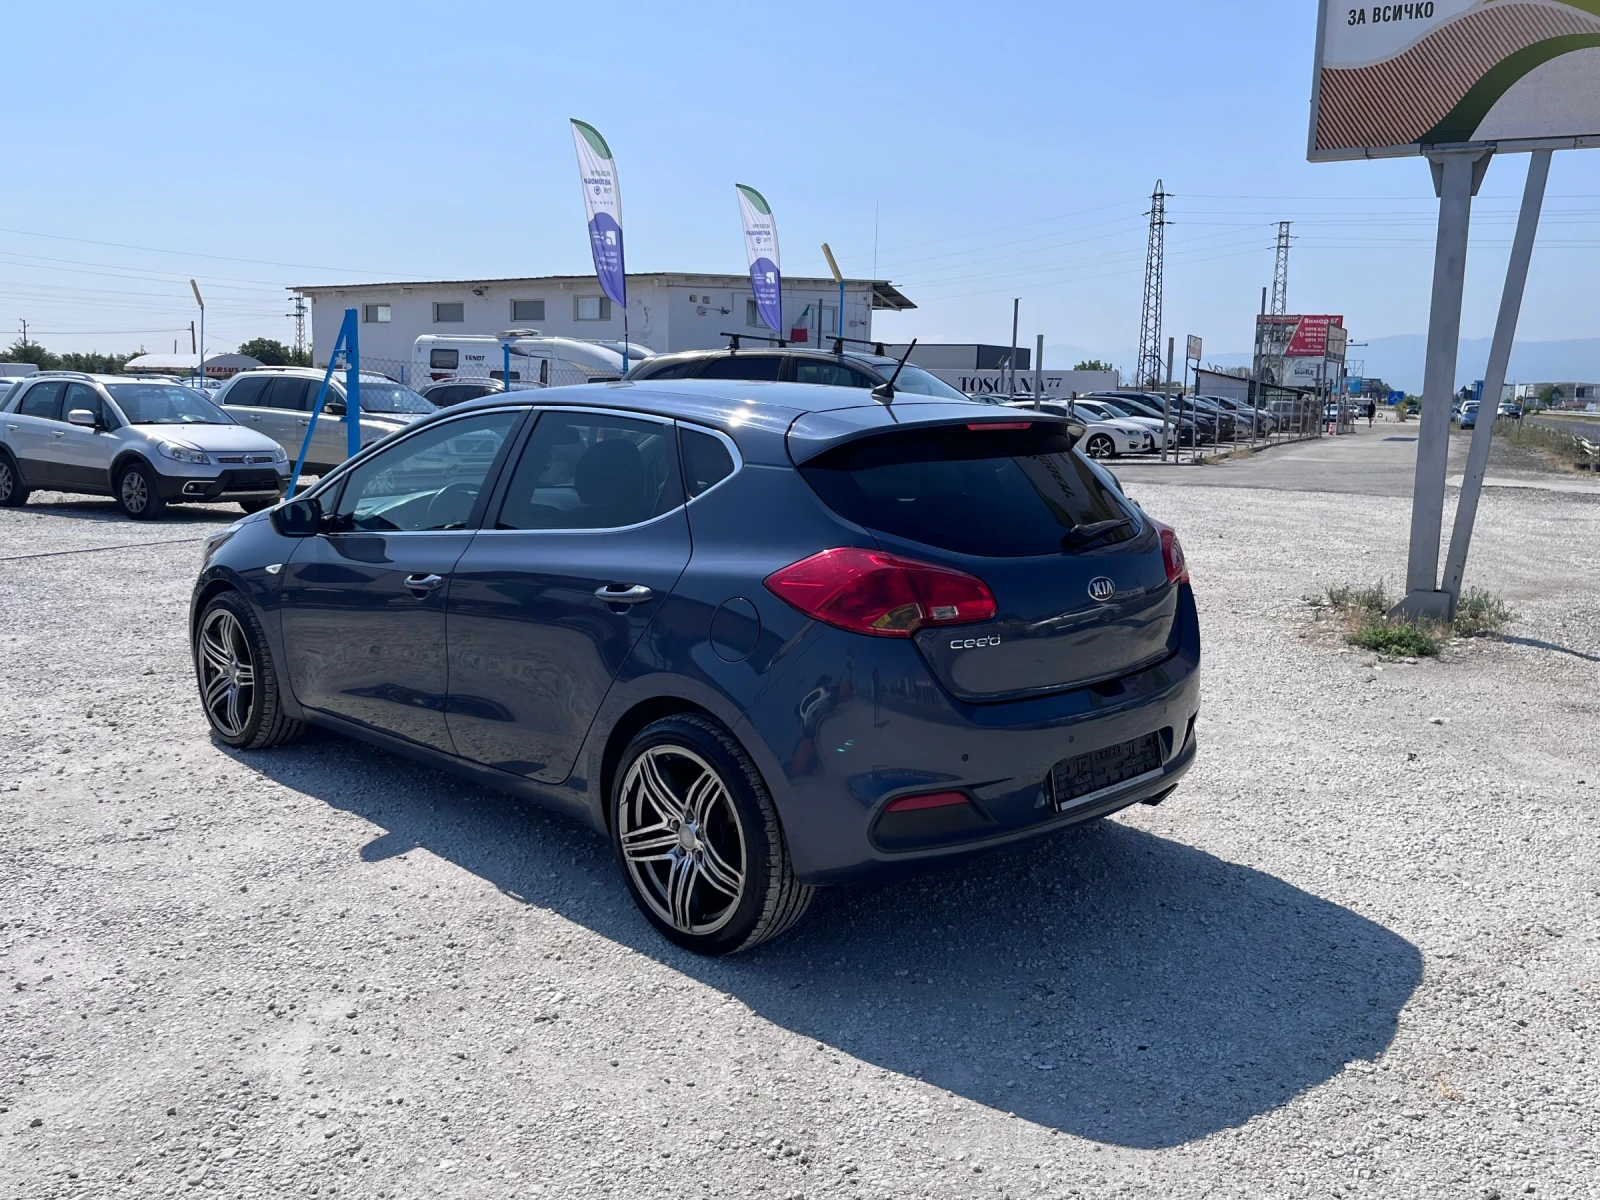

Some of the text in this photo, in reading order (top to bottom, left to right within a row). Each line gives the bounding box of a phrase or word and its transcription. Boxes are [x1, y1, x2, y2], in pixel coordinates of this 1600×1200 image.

[1347, 1, 1434, 26] ЗА ВСИЧКО
[1046, 377, 1062, 388] 77
[1092, 580, 1113, 596] KIA
